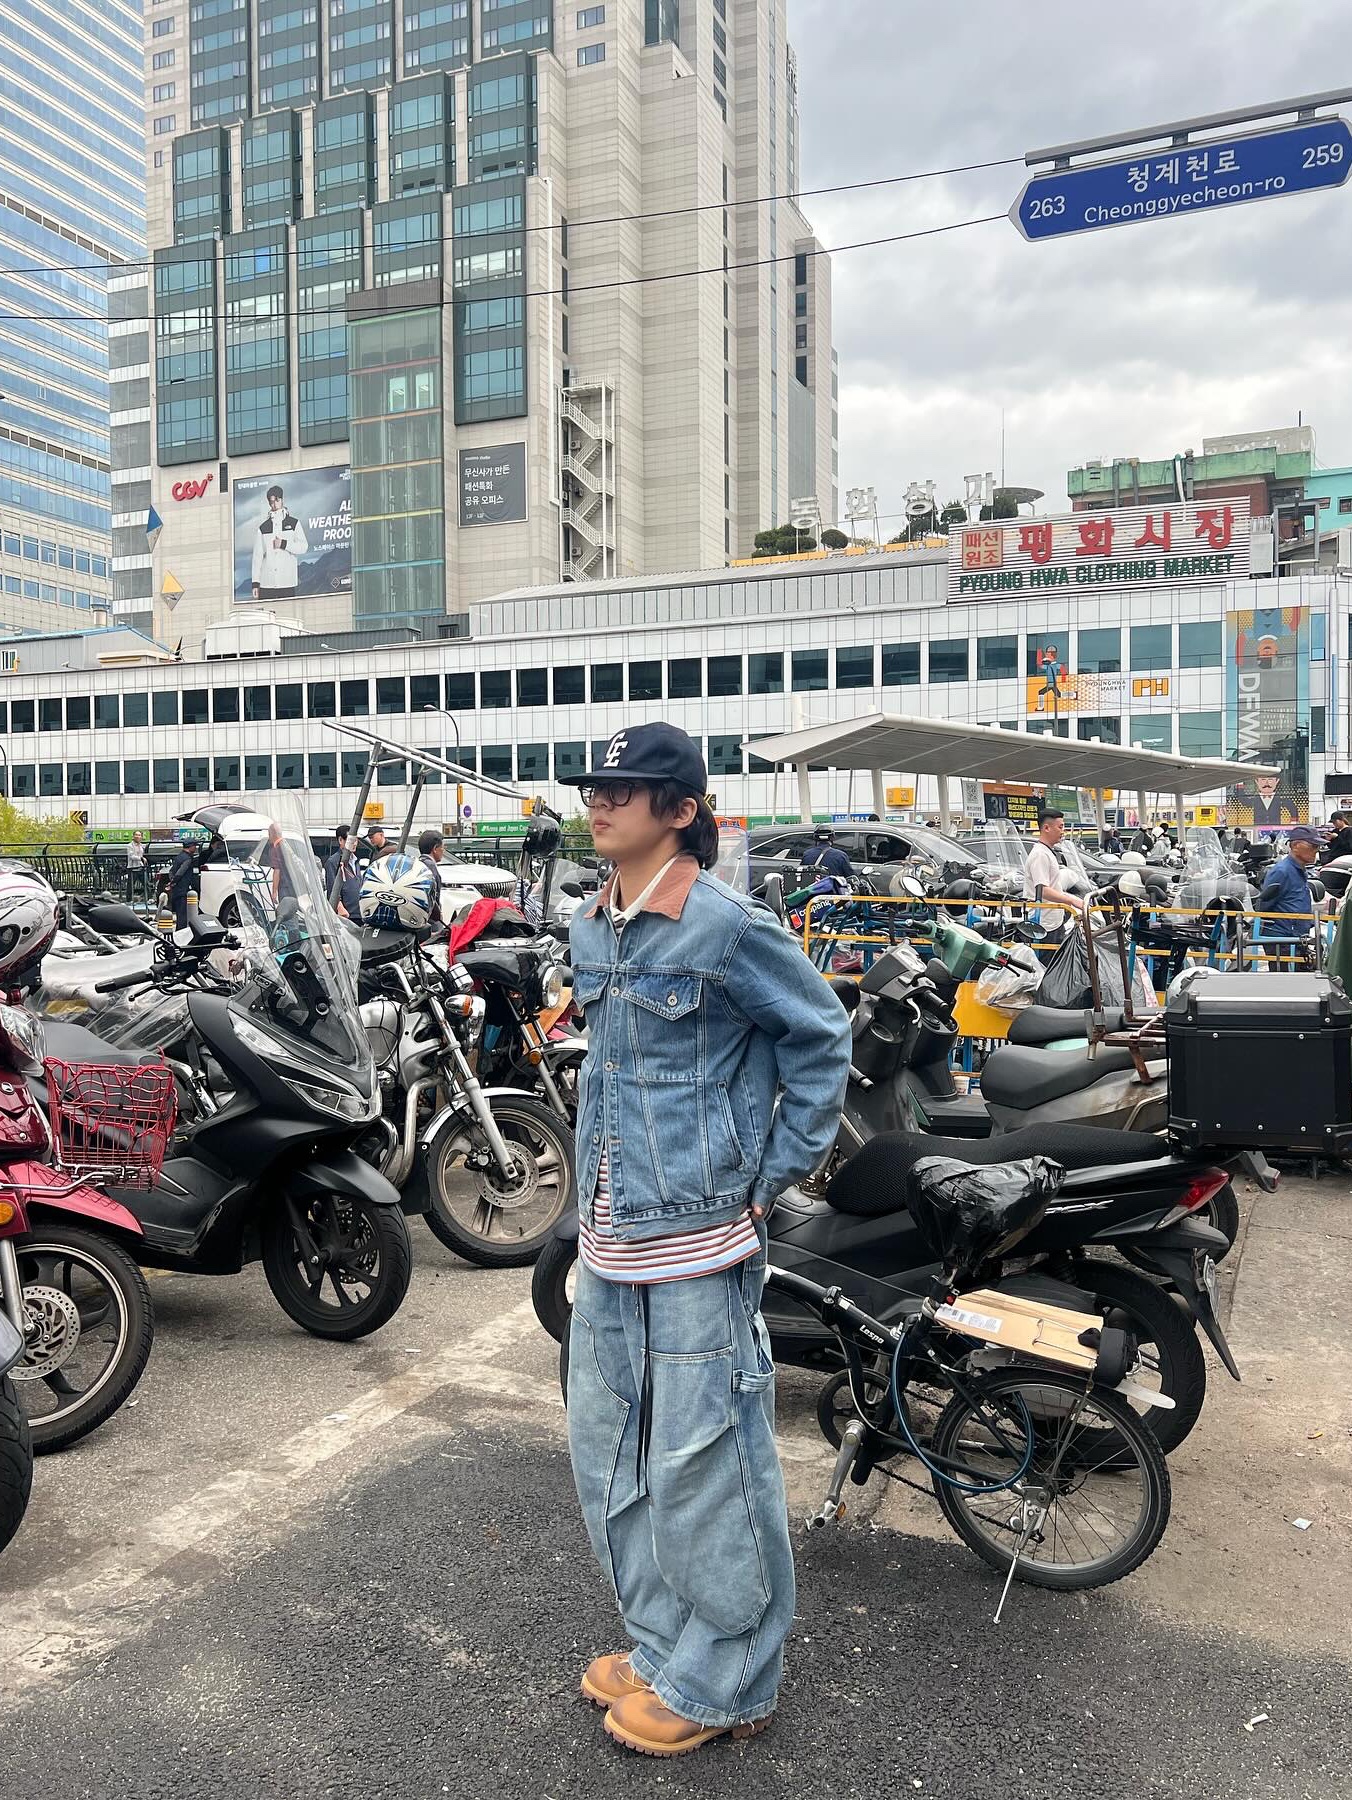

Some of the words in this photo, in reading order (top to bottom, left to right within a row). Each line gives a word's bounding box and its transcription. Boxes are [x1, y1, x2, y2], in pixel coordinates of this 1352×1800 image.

[1302, 142, 1344, 169] 259
[1127, 149, 1240, 193] 청계천로
[1029, 196, 1066, 219] 263
[1084, 175, 1286, 223] Cheonggyecheon-ro
[464, 467, 494, 478] 무신사가
[171, 479, 208, 501] CGV
[464, 496, 480, 506] 공유
[481, 494, 504, 505] 오피스
[339, 500, 352, 512] AL
[308, 514, 352, 529] WEATHE
[323, 528, 352, 541] PROO
[1018, 506, 1234, 564] 평화시장
[965, 549, 999, 566] 원조
[959, 570, 1022, 593] PYOUNG
[1030, 566, 1069, 587] HWA
[1076, 560, 1156, 584] CLOTHING
[1164, 553, 1234, 577] MARKET
[799, 900, 831, 917] cpang
[859, 1324, 885, 1344] Lespo
